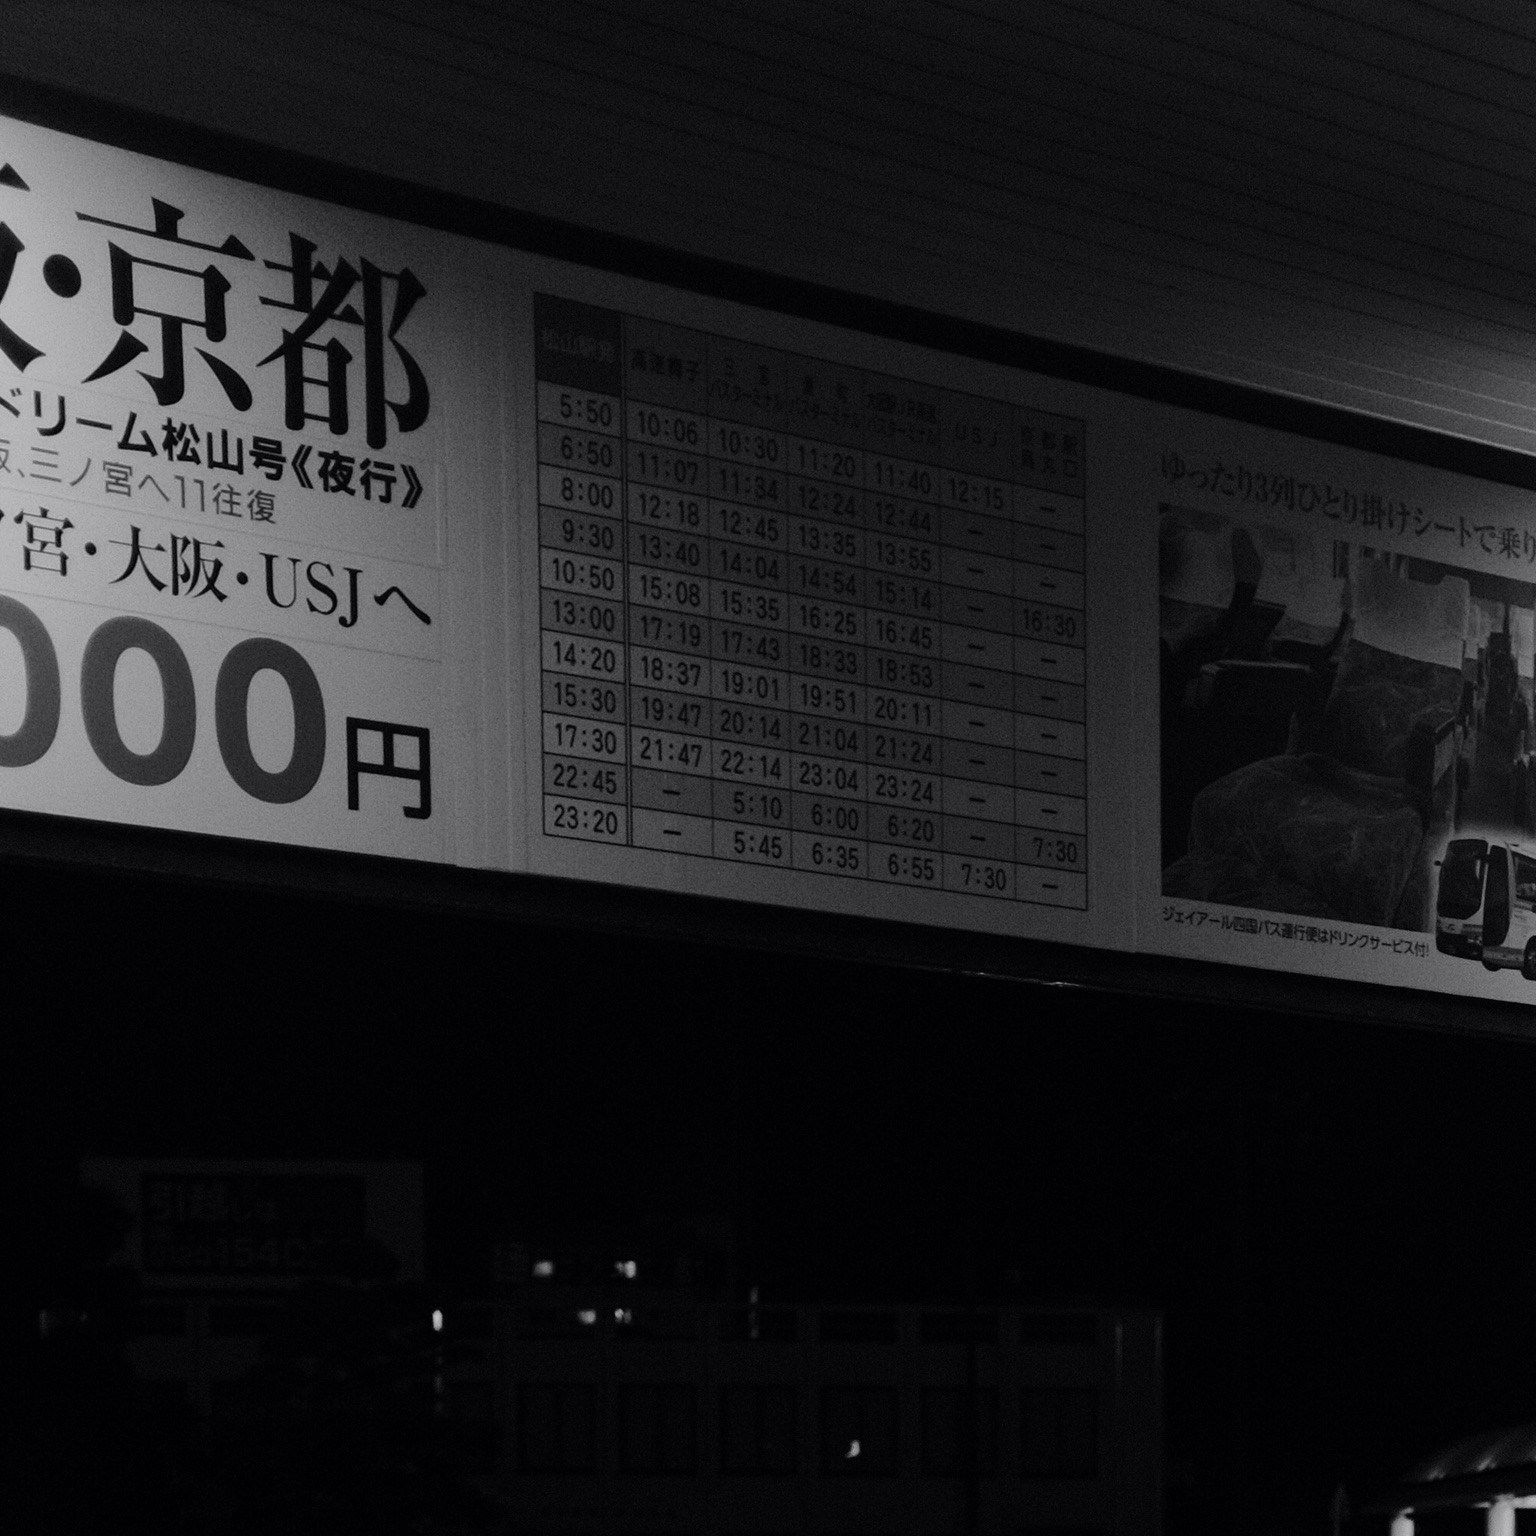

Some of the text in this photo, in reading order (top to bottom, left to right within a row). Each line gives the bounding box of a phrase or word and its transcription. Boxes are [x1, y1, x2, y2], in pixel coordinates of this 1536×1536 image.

[0, 163, 430, 449] ・京都
[0, 439, 277, 524] 、三ノ宮へ11往復
[560, 394, 1003, 510] 5:50 10:06 10:30 11:20 11:40 12:15
[561, 436, 930, 533] 6:50 11:07 11:34 12:24 12:44
[0, 507, 431, 627] 宮・大阪・USJへ
[562, 478, 931, 572] 8:00 12:18 12:45 13:35 13:55
[553, 558, 932, 649] 10:50 15:08 15:35 16:25 16:45
[562, 519, 1075, 638] 9:30 13:40 14:04 14:54 15:14 16:30
[554, 600, 932, 688] 13:00 17:19 17:43 18:33 18:53
[554, 641, 932, 726] 14:20 18:37 19:01 19:51 20:11
[554, 682, 932, 764] 15:30 19:47 20:14 21:04 21:24
[556, 723, 933, 804] 17:30 21:47 22:14 23:04 23:24
[554, 764, 1077, 863] 22:45 5:10 6:00 6:20 7:30
[554, 805, 1006, 890] 23:20 5:45 6:35 6:55 7:30
